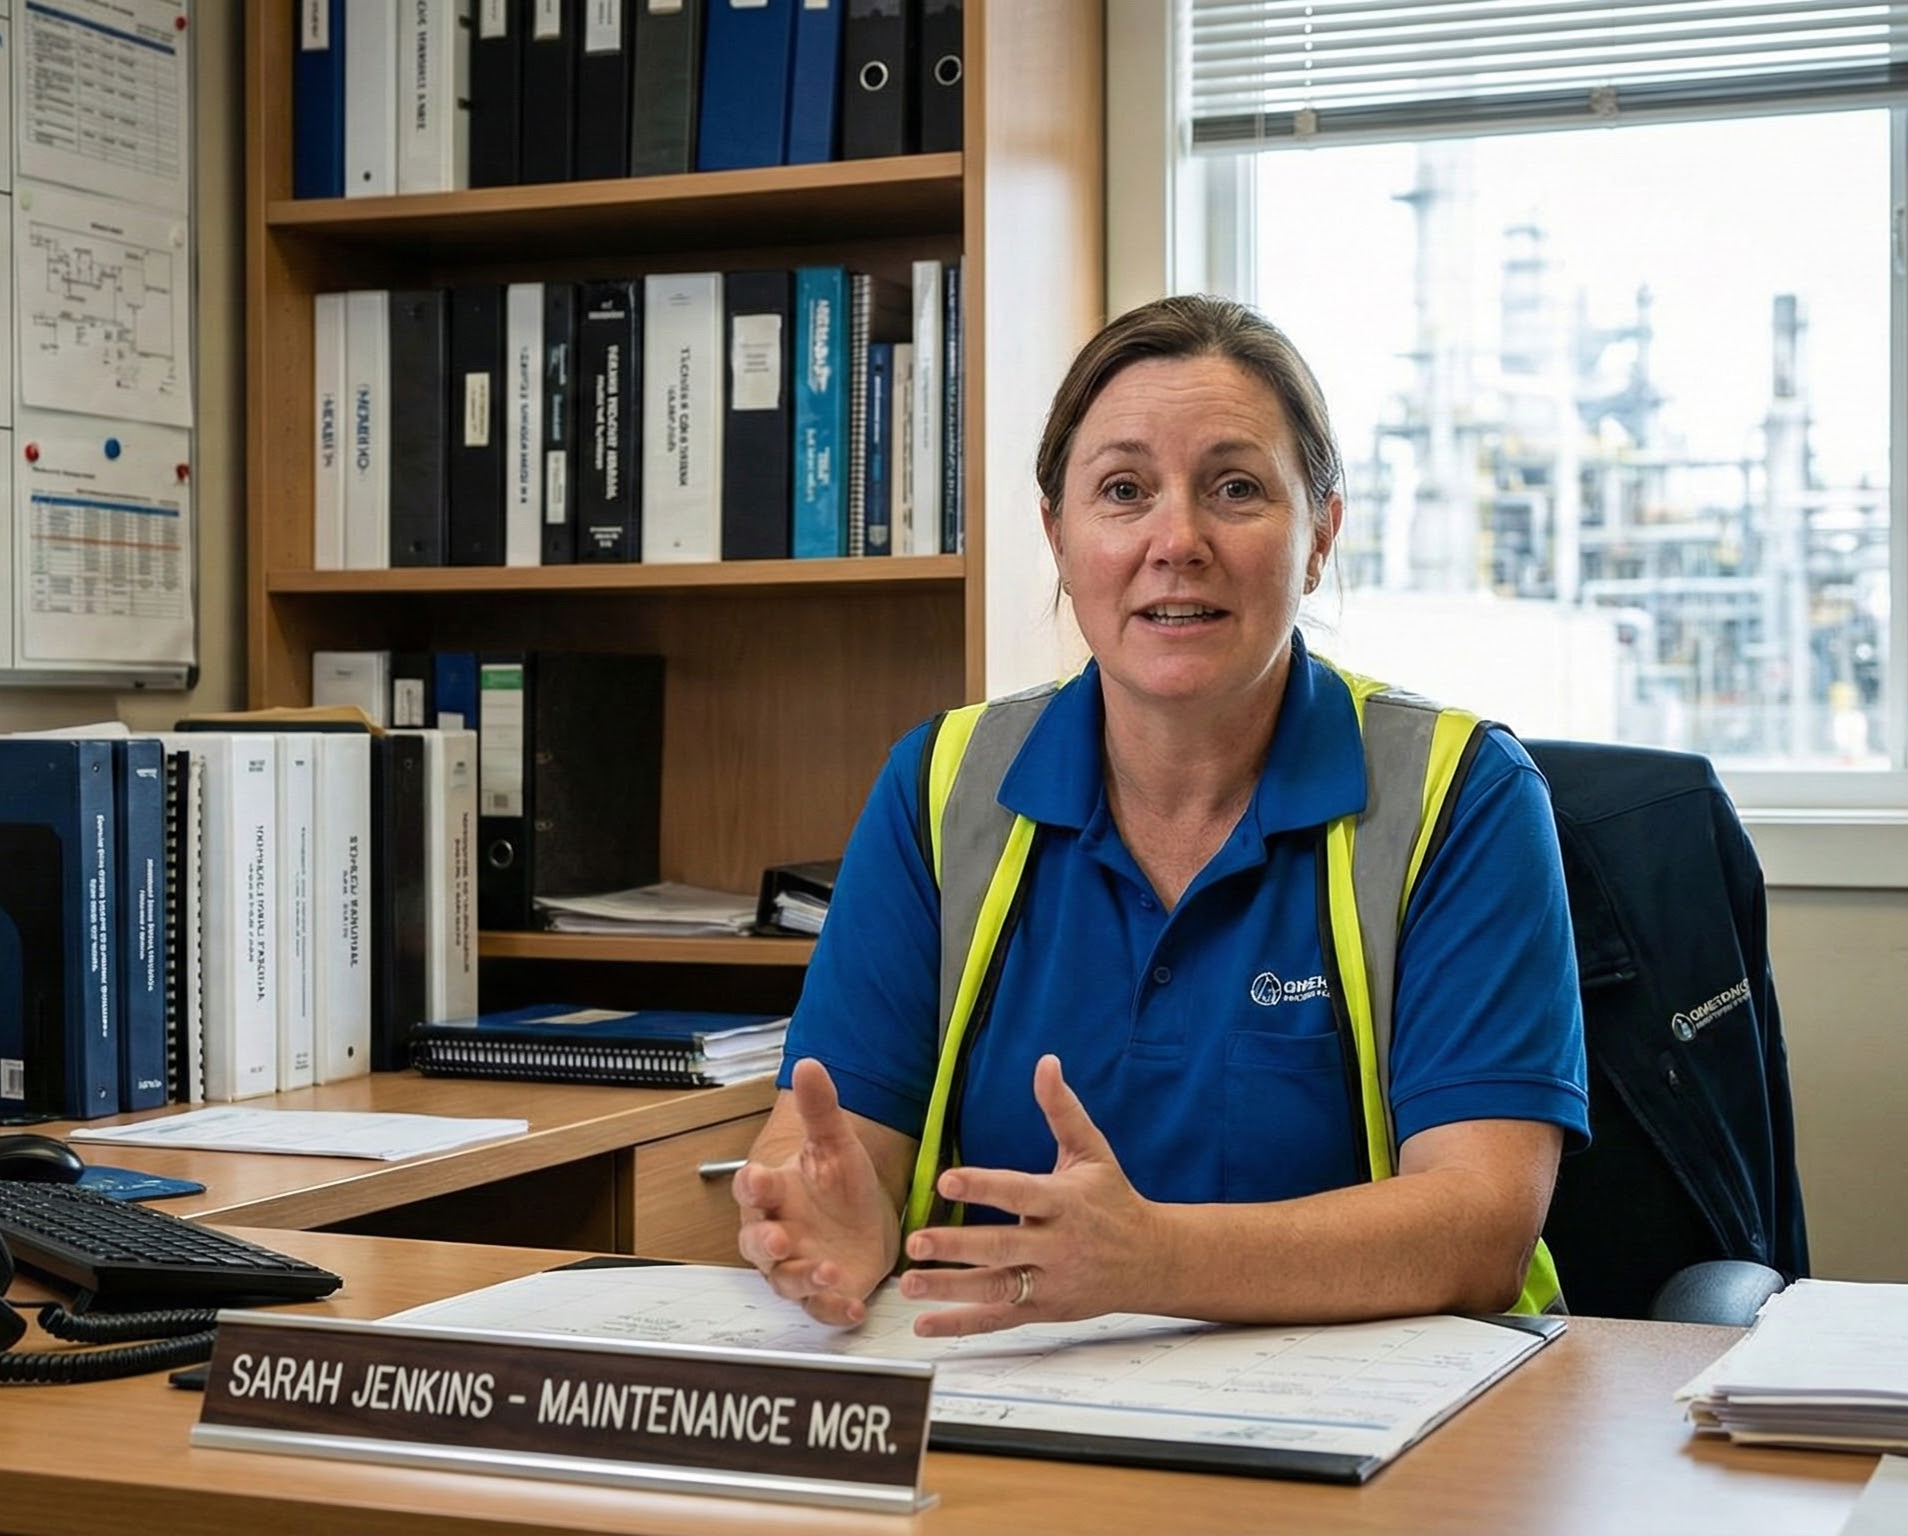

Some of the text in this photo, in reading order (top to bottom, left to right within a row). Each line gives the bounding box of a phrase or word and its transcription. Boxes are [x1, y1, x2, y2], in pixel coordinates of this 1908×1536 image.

[229, 1354, 343, 1404] SARAH
[352, 1365, 495, 1418] JENKINS
[538, 1378, 796, 1445] MAINTENANCE
[808, 1401, 897, 1453] MGR.
